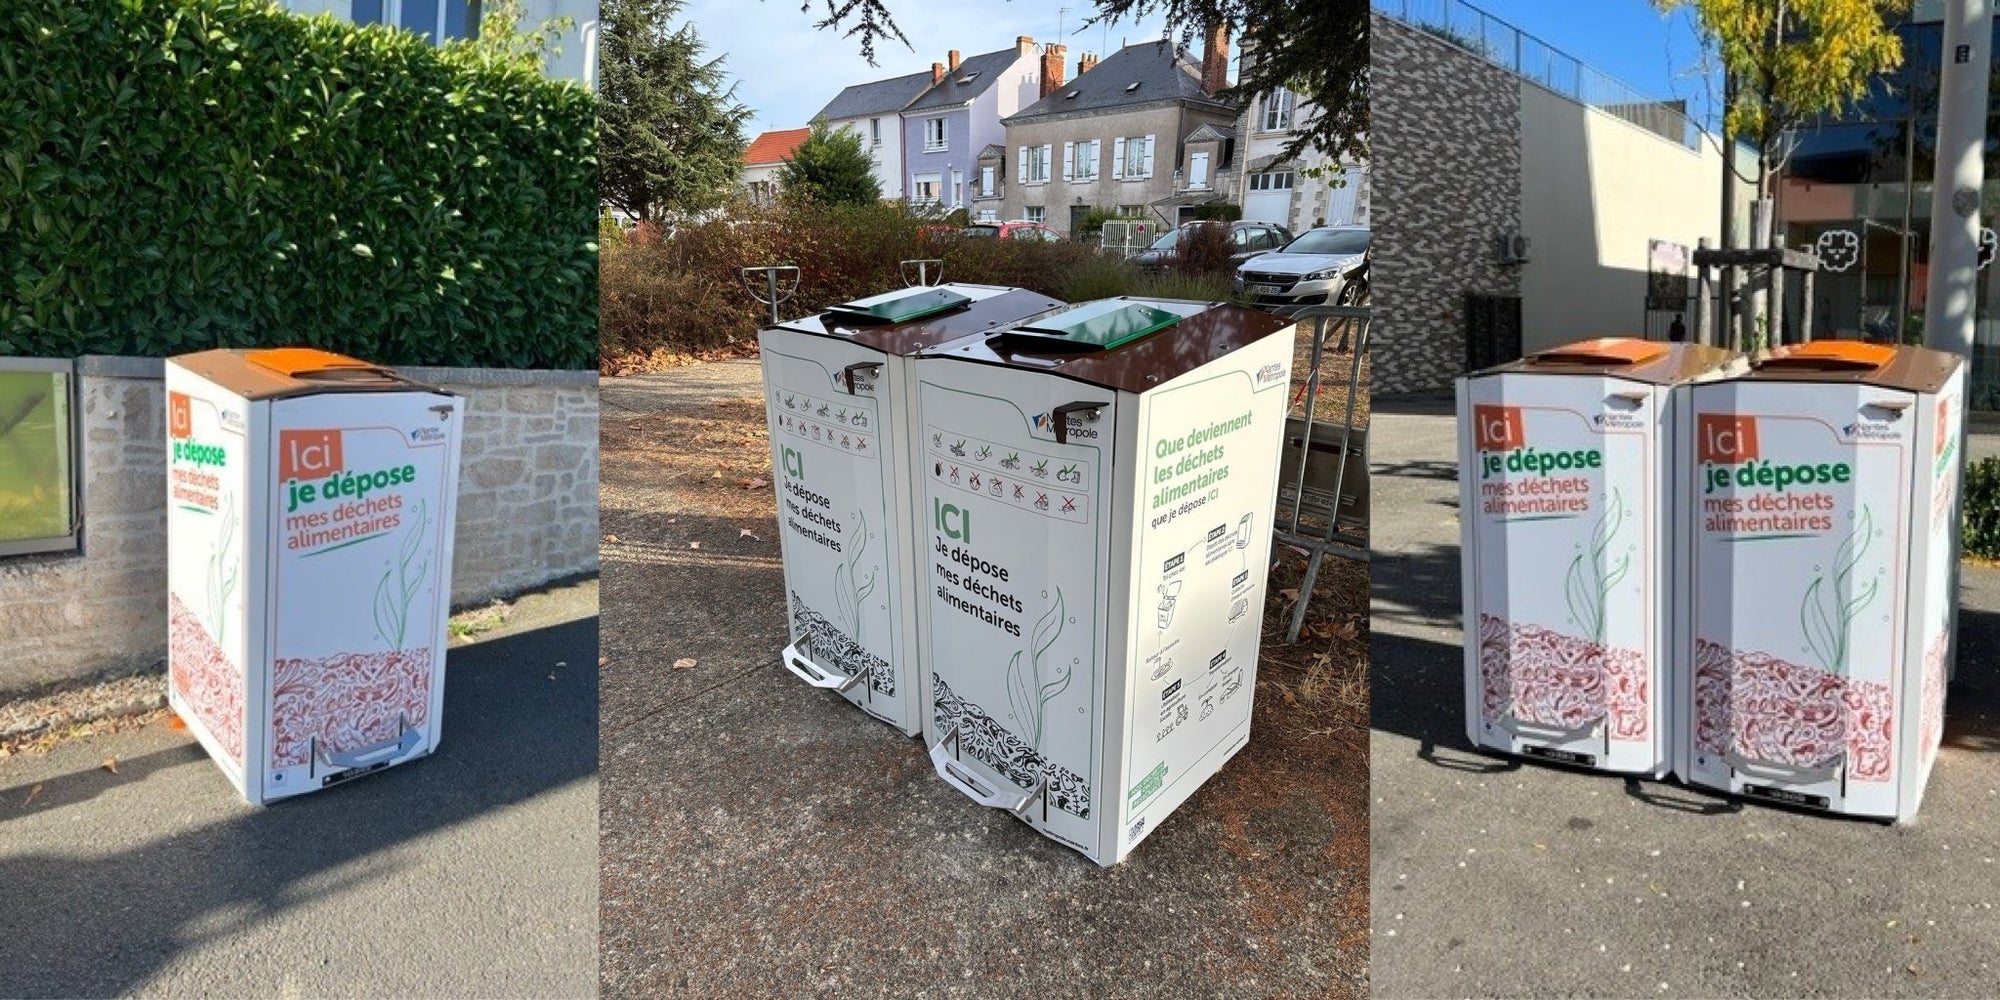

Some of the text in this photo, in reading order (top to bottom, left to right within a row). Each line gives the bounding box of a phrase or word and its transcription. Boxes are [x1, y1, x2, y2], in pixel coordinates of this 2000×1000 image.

[1155, 409, 1252, 459] Que deviennent
[1481, 412, 1513, 443] Ici
[1707, 421, 1745, 455] Ici
[173, 438, 226, 468] je dépose
[290, 436, 331, 472] Ici
[781, 443, 804, 480] ICI
[1154, 445, 1224, 484] les déchets
[1482, 447, 1602, 479] je dépose
[288, 465, 415, 512] je dépose
[784, 475, 830, 509] Je dépose
[1152, 465, 1229, 509] alimentaires
[1482, 478, 1589, 496] mes déchets
[1705, 459, 1850, 494] je dépose
[287, 494, 403, 530] mes déchets
[786, 498, 841, 533] mes déchets
[934, 497, 970, 544] ICI
[1151, 487, 1219, 529] que je dépose ICI
[1484, 496, 1589, 514] alimentaires
[1705, 492, 1835, 513] mes déchets
[287, 514, 401, 549] alimentaires
[788, 516, 842, 552] alimentaires
[1705, 511, 1833, 532] alimentaires
[935, 536, 1009, 582] Je dépose
[936, 563, 1023, 613] mes déchets
[937, 585, 1021, 637] alimentaires
